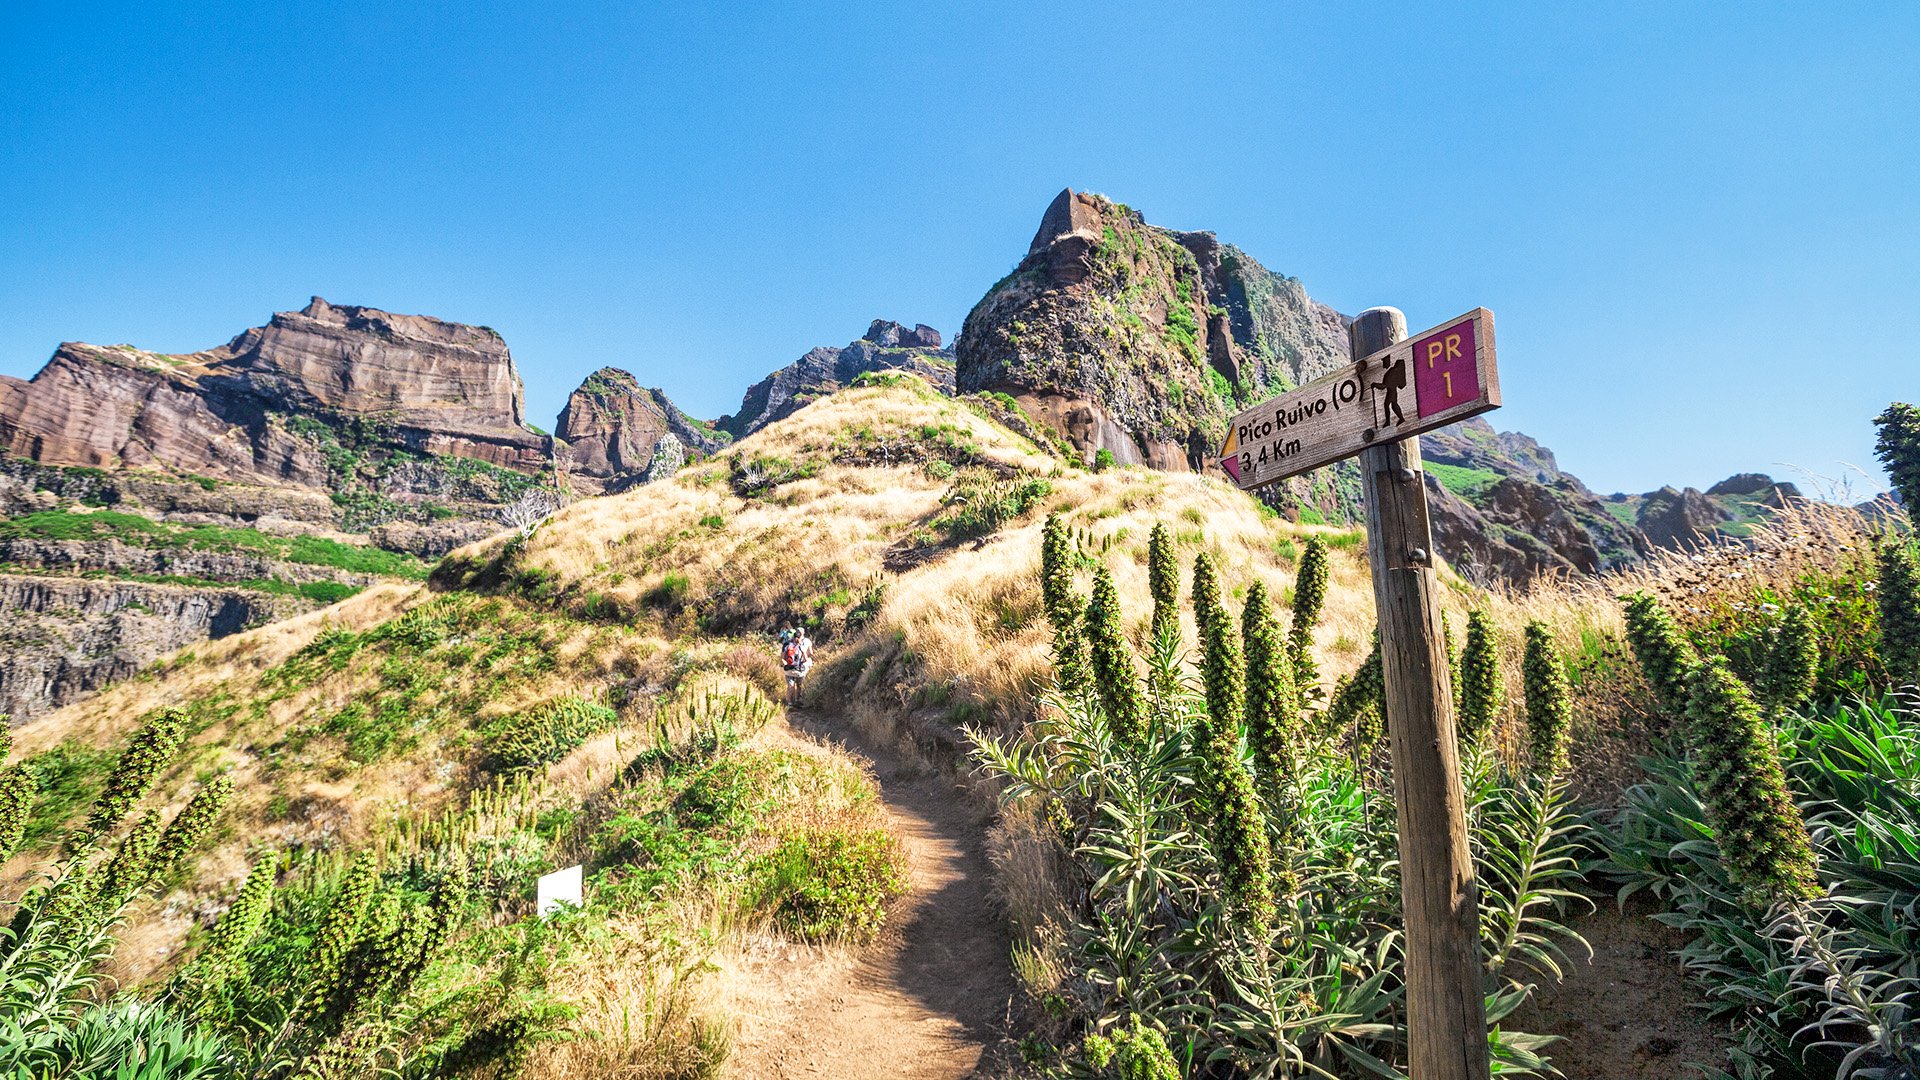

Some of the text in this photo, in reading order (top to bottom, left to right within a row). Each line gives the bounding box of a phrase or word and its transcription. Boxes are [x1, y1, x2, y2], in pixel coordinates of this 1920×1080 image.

[1427, 334, 1462, 369] PR
[1442, 371, 1453, 399] 1
[1239, 374, 1364, 445] Pico Ruivo (O)
[1241, 438, 1301, 474] 3,4 Km
